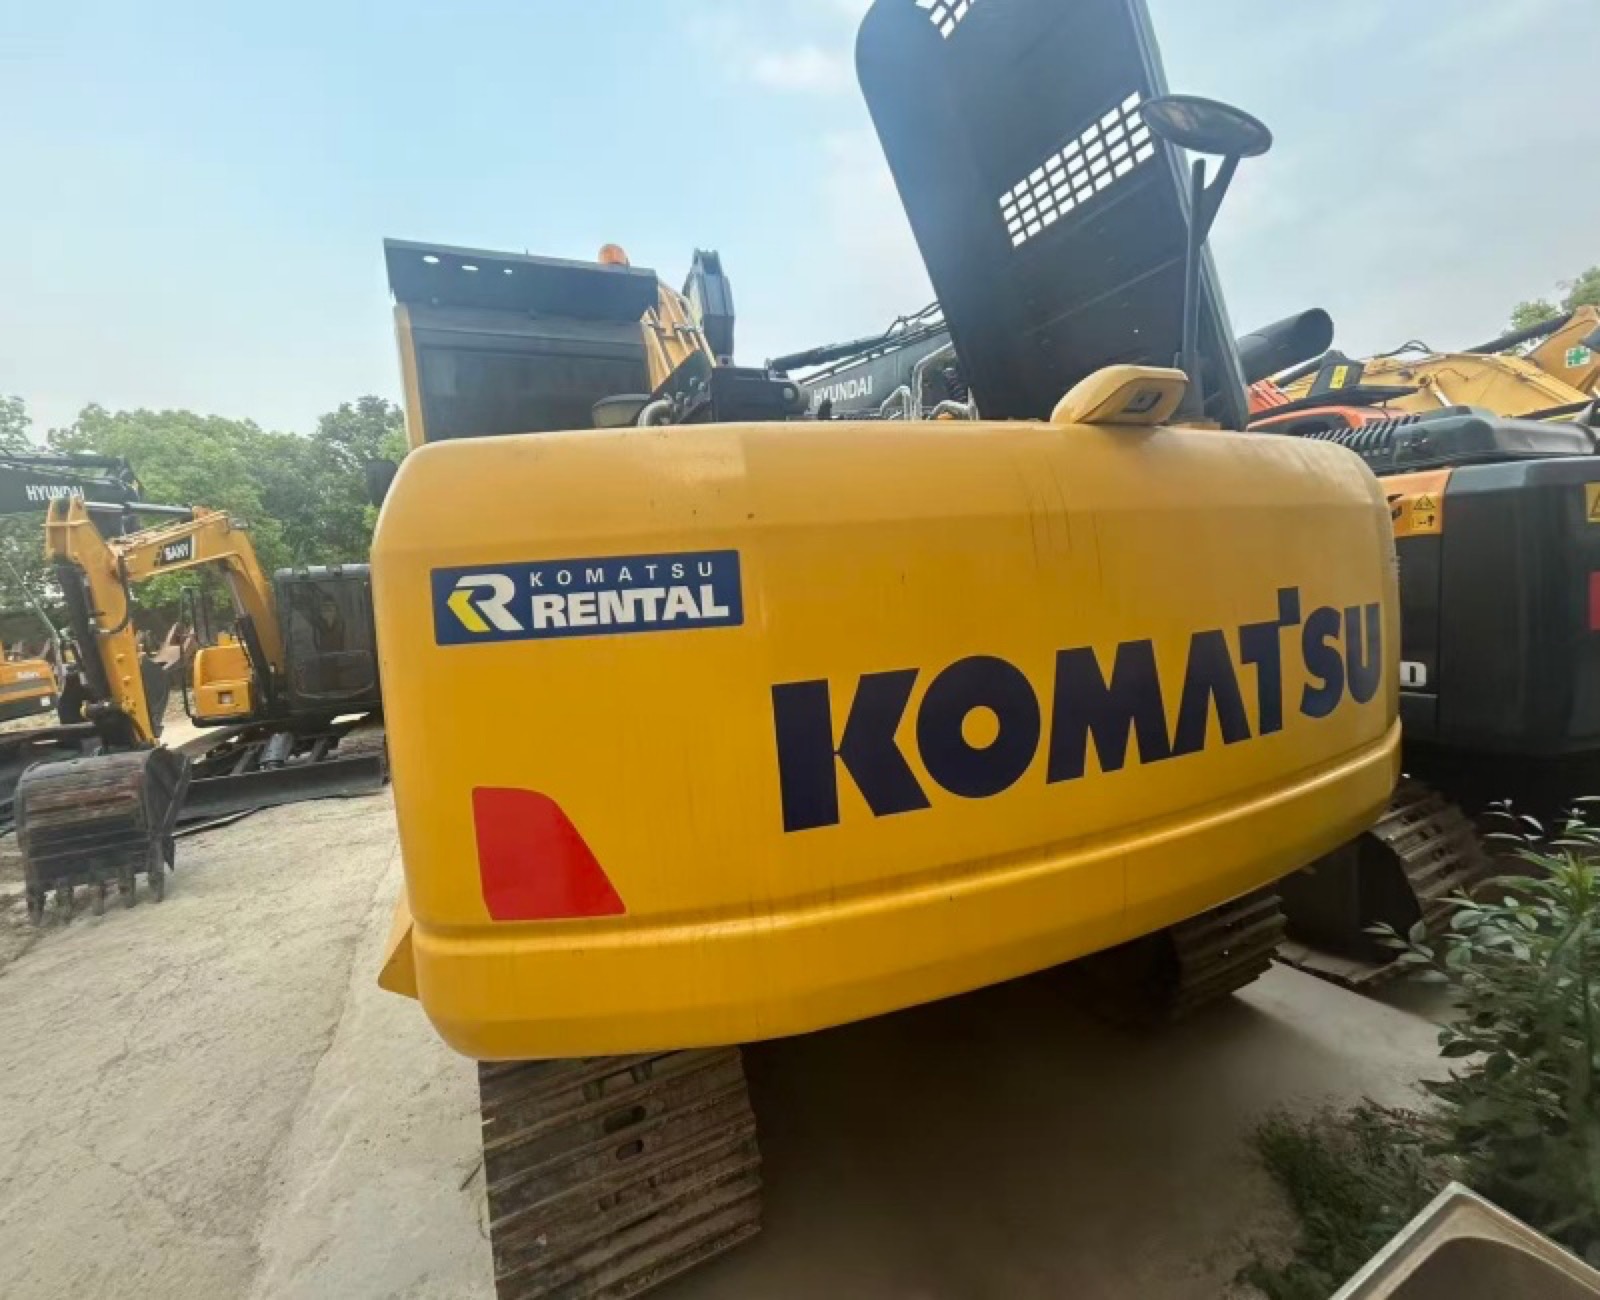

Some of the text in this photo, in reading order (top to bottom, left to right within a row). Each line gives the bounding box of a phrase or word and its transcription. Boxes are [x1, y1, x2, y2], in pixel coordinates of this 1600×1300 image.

[813, 375, 873, 406] HYUNDAI
[530, 562, 712, 586] KOMATSU
[531, 584, 730, 629] RENTAL
[771, 586, 1381, 833] KOMATSU
